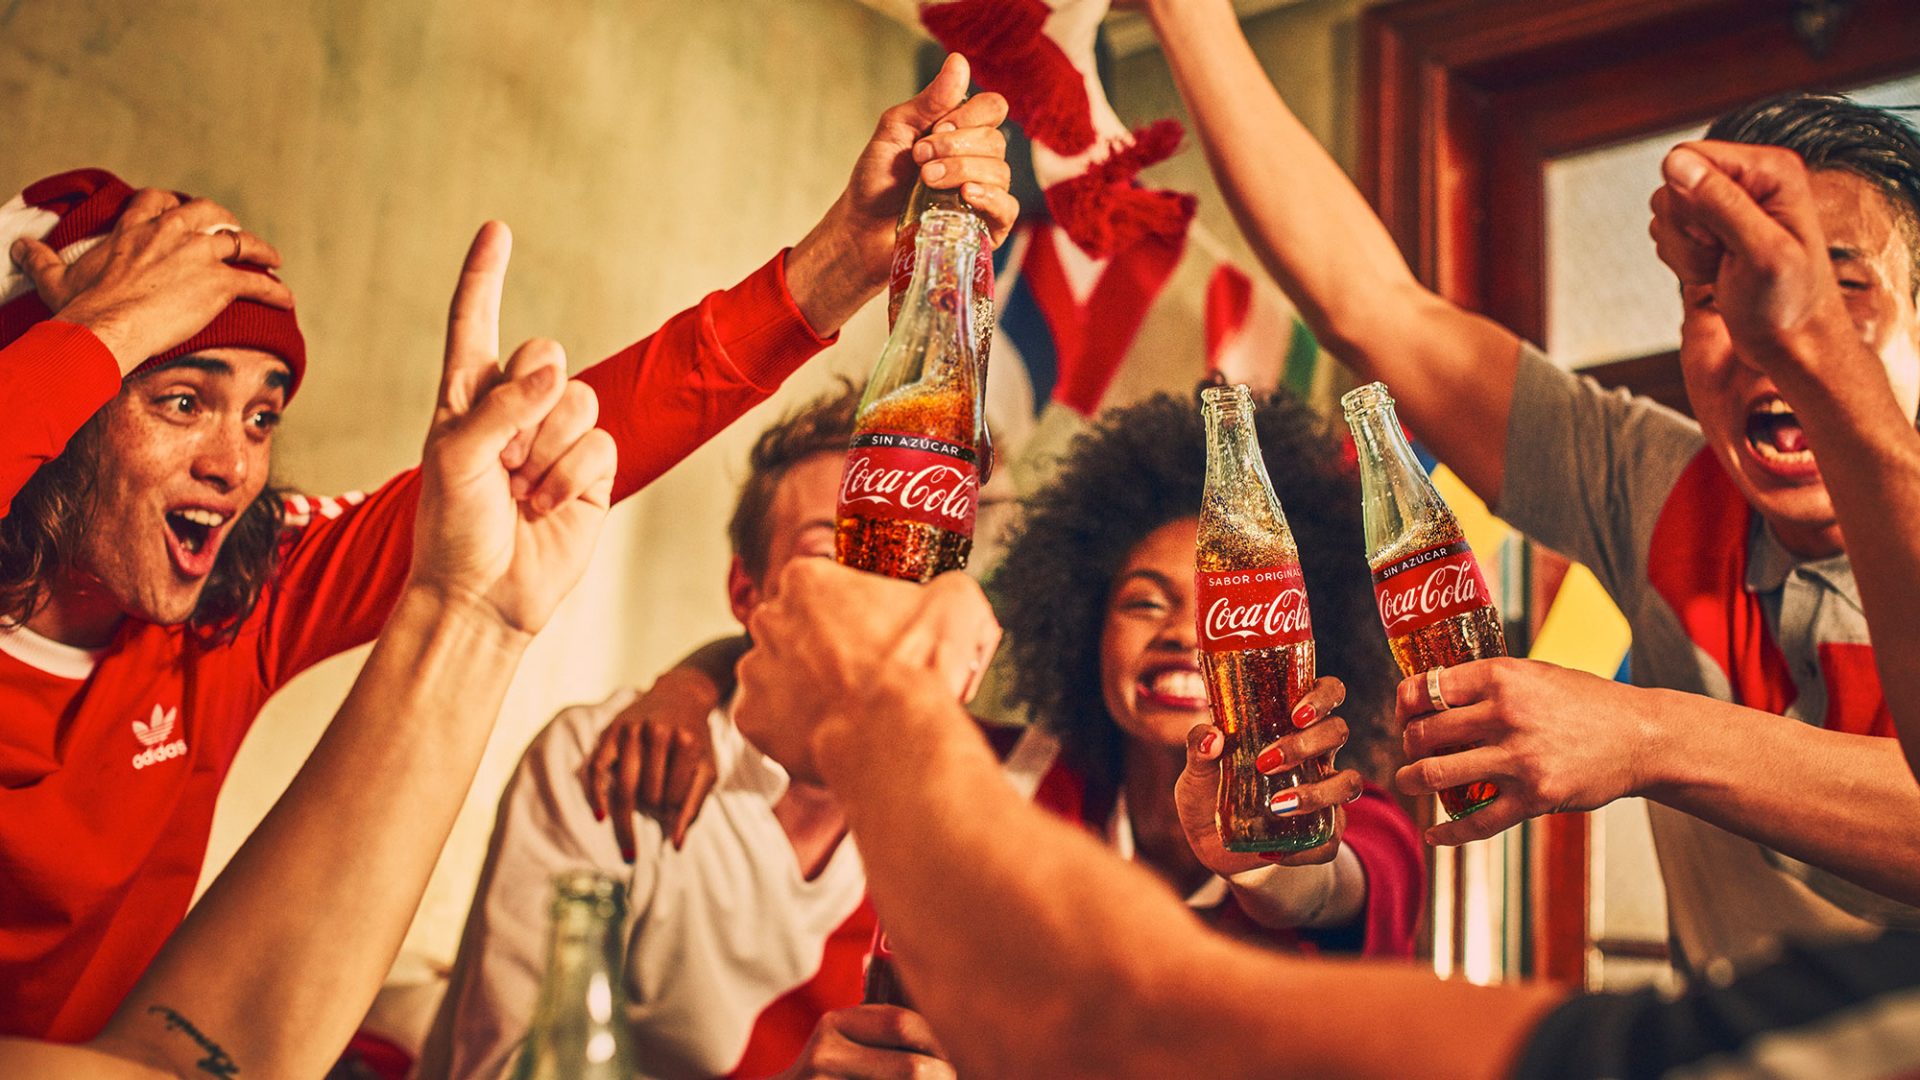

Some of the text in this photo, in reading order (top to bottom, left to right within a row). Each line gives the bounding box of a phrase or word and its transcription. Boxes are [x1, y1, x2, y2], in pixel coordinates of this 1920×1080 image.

[872, 435, 959, 456] SIN AZÚCAR
[842, 457, 976, 520] Coca-Cola
[1383, 547, 1448, 578] SIN AZÚCAR
[1208, 574, 1250, 587] SABOR
[1380, 560, 1477, 629] Coca-Cola
[1205, 587, 1309, 640] Coca-Cola
[132, 739, 187, 770] adidas
